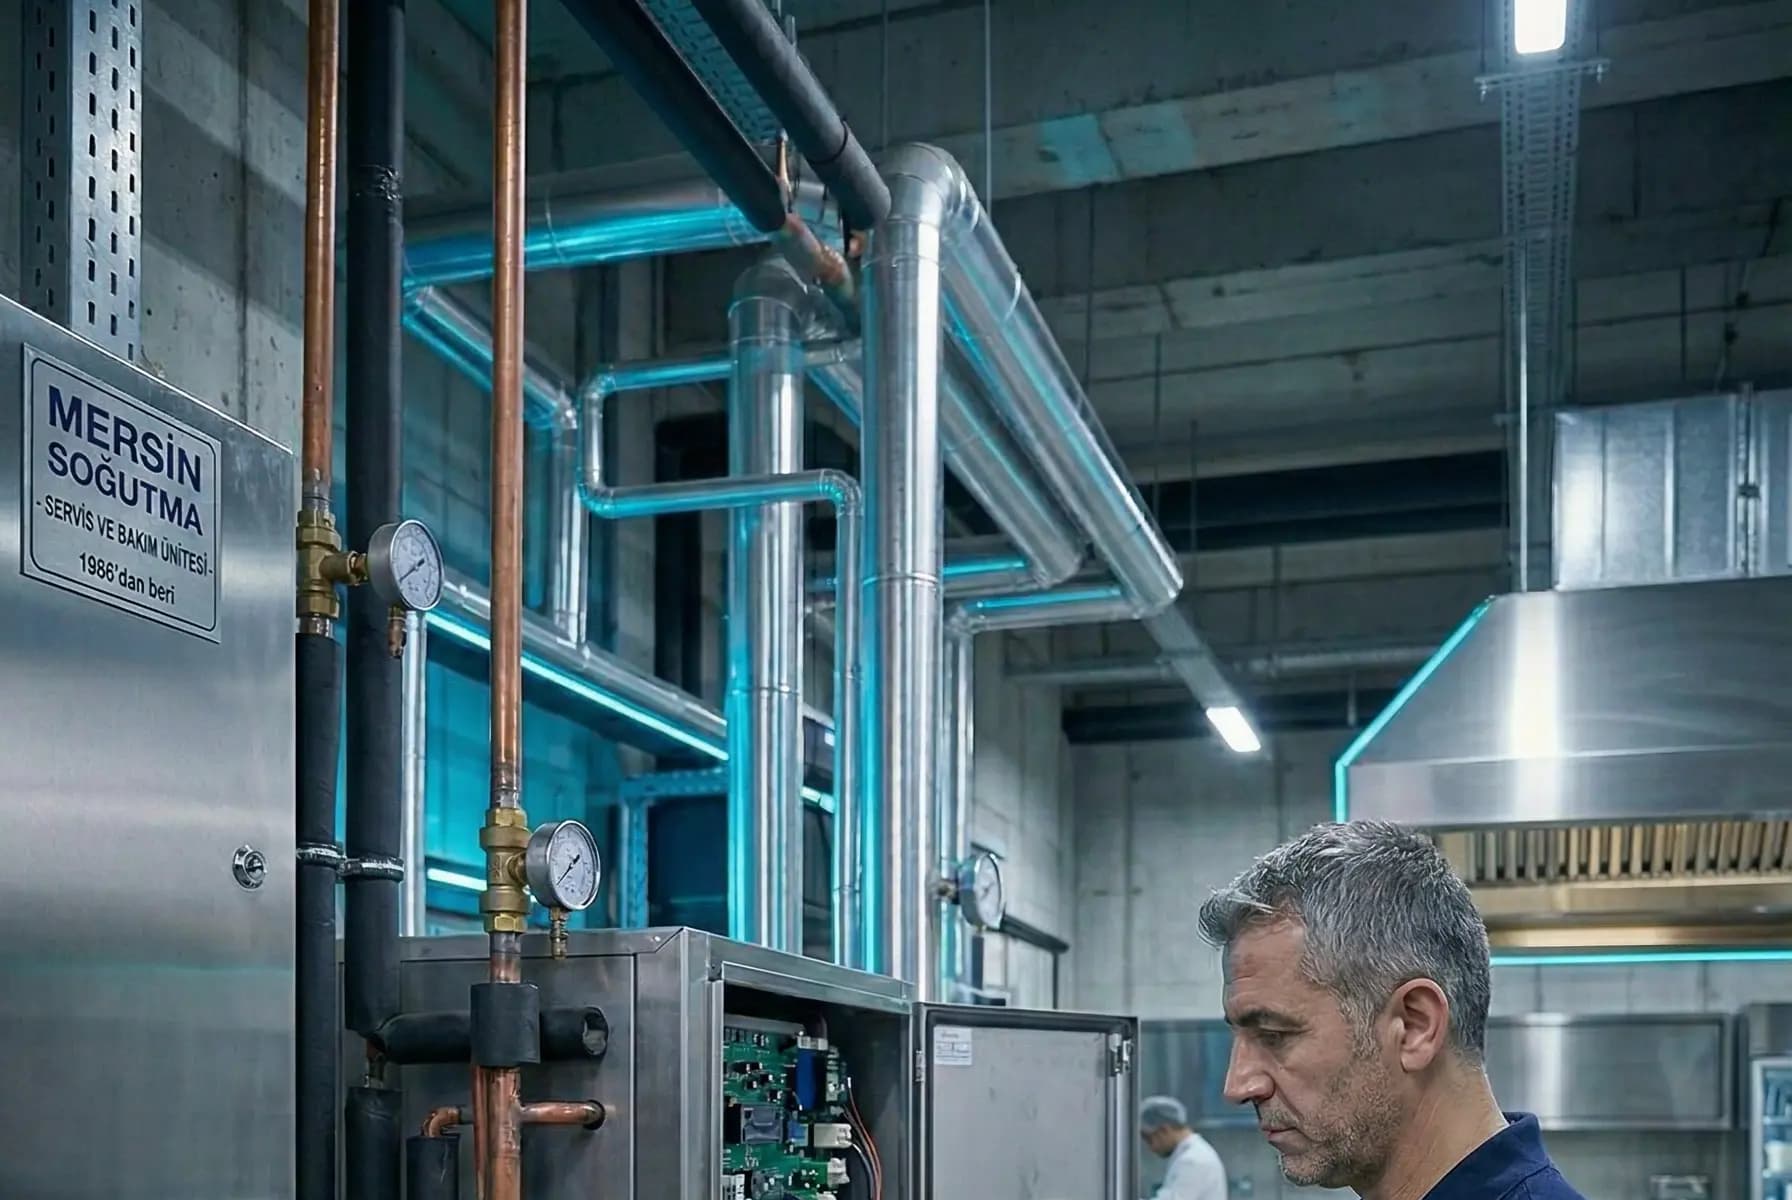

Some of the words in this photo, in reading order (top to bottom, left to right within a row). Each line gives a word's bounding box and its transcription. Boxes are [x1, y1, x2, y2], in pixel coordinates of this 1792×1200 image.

[48, 385, 201, 493] MERSİN
[45, 495, 94, 532] SERVİS
[97, 515, 114, 540] VE
[118, 524, 158, 558] BAKIM
[48, 442, 203, 536] SOĞUTMA
[80, 552, 145, 593] 1986'dan
[149, 577, 175, 604] beri
